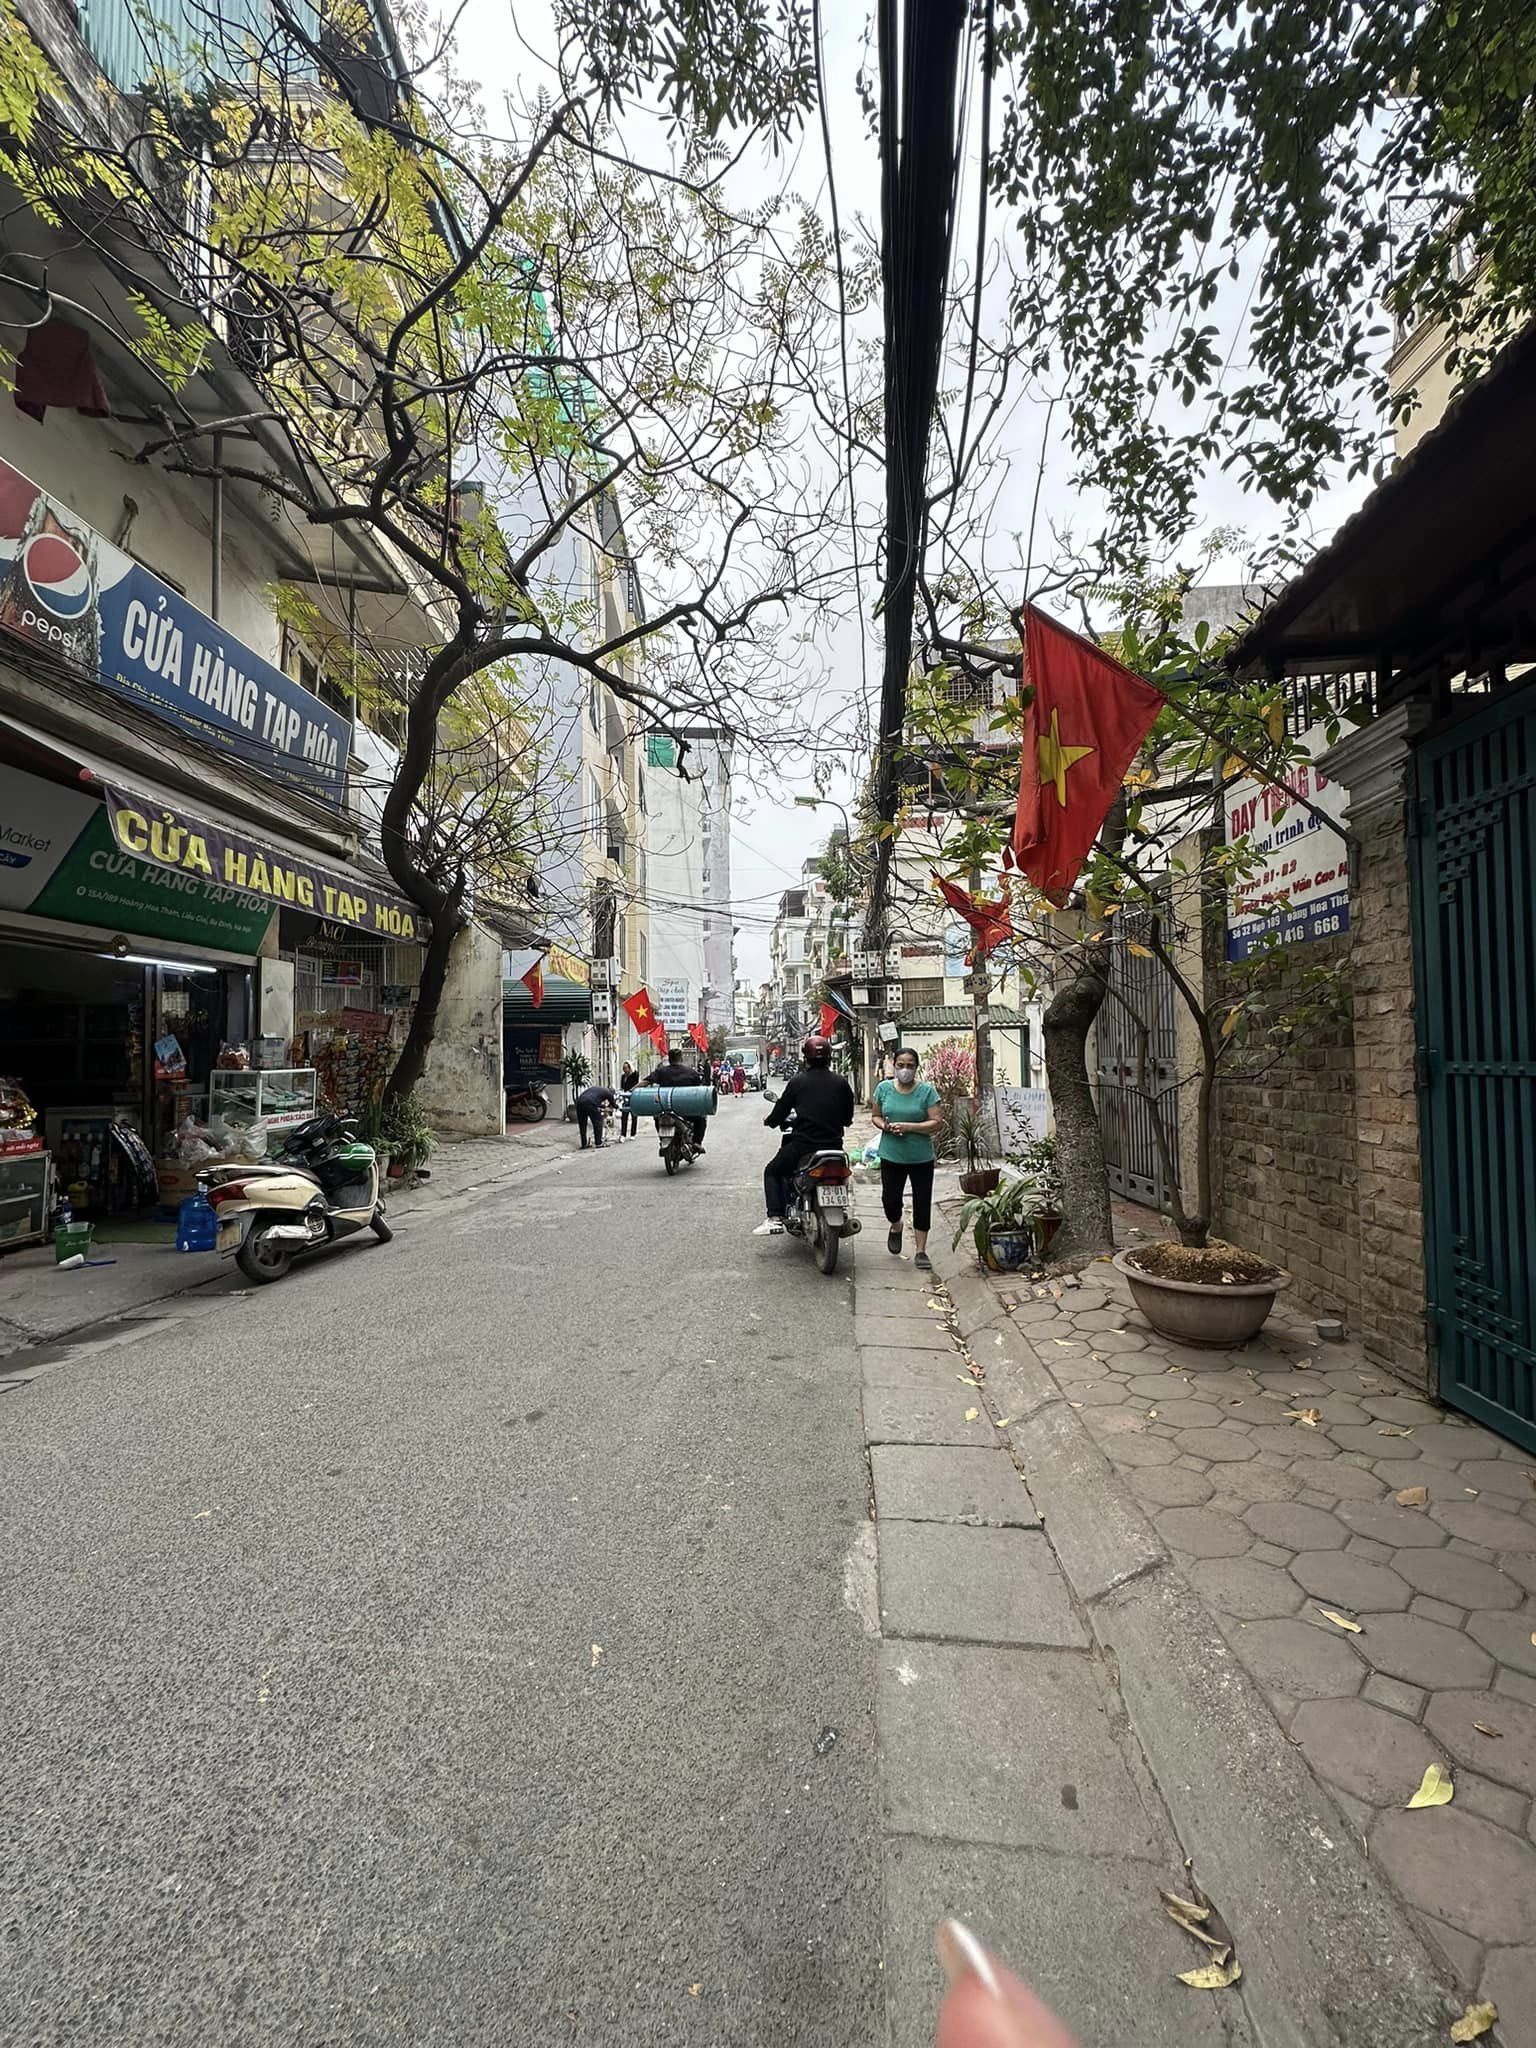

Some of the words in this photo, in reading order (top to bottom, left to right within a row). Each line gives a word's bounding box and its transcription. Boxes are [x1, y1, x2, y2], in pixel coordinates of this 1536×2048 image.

[20, 609, 78, 651] pepsi
[122, 594, 184, 687] CỬA
[188, 643, 259, 731] HÀNG
[262, 691, 301, 757] TẠP
[303, 720, 338, 779] HÓA
[115, 811, 212, 876] CỬA
[223, 846, 315, 908] HÀNG
[322, 884, 368, 925] TẠP
[375, 903, 415, 939] HÓA
[1242, 925, 1251, 936] 32
[1284, 925, 1304, 944] 416
[1314, 915, 1340, 936] 668
